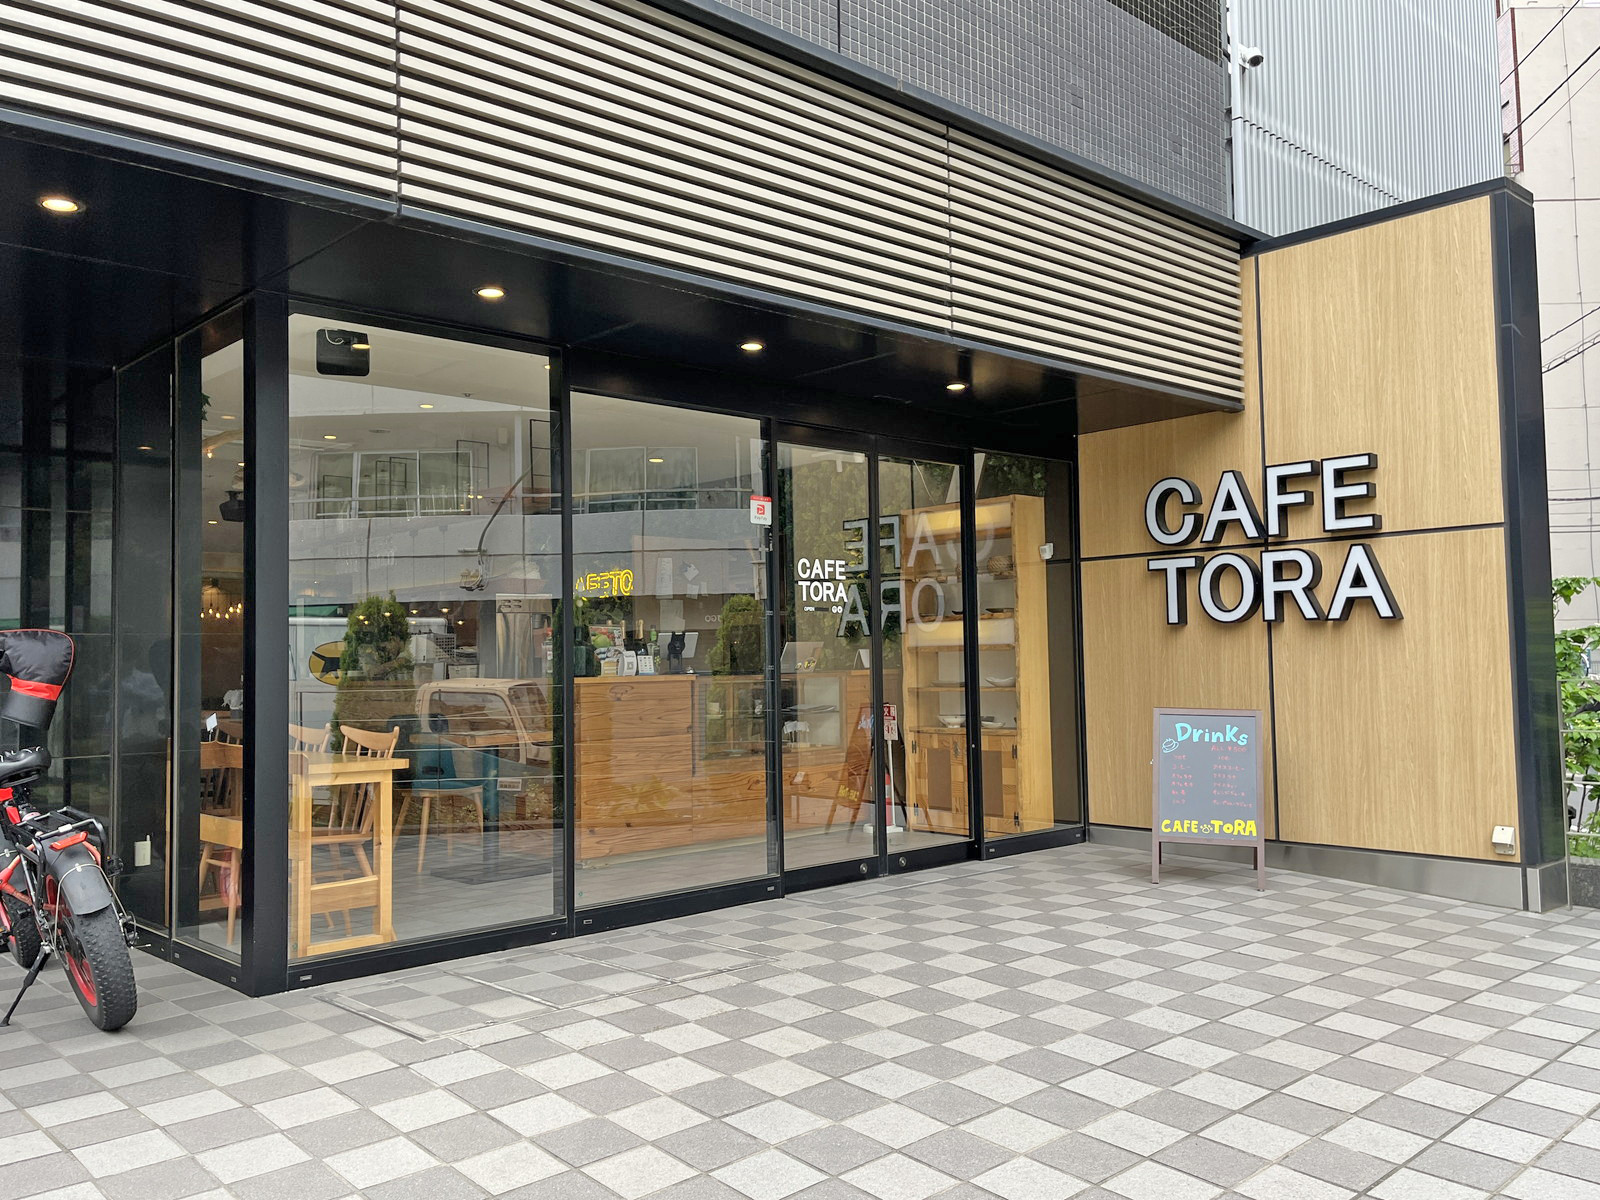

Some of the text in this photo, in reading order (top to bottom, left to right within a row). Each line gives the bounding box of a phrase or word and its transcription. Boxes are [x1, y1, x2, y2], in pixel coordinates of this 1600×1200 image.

[1145, 453, 1382, 546] CAFE
[797, 557, 846, 580] CAFE
[797, 580, 848, 603] TORA
[1148, 543, 1403, 625] TORA
[1161, 819, 1199, 833] CAFE
